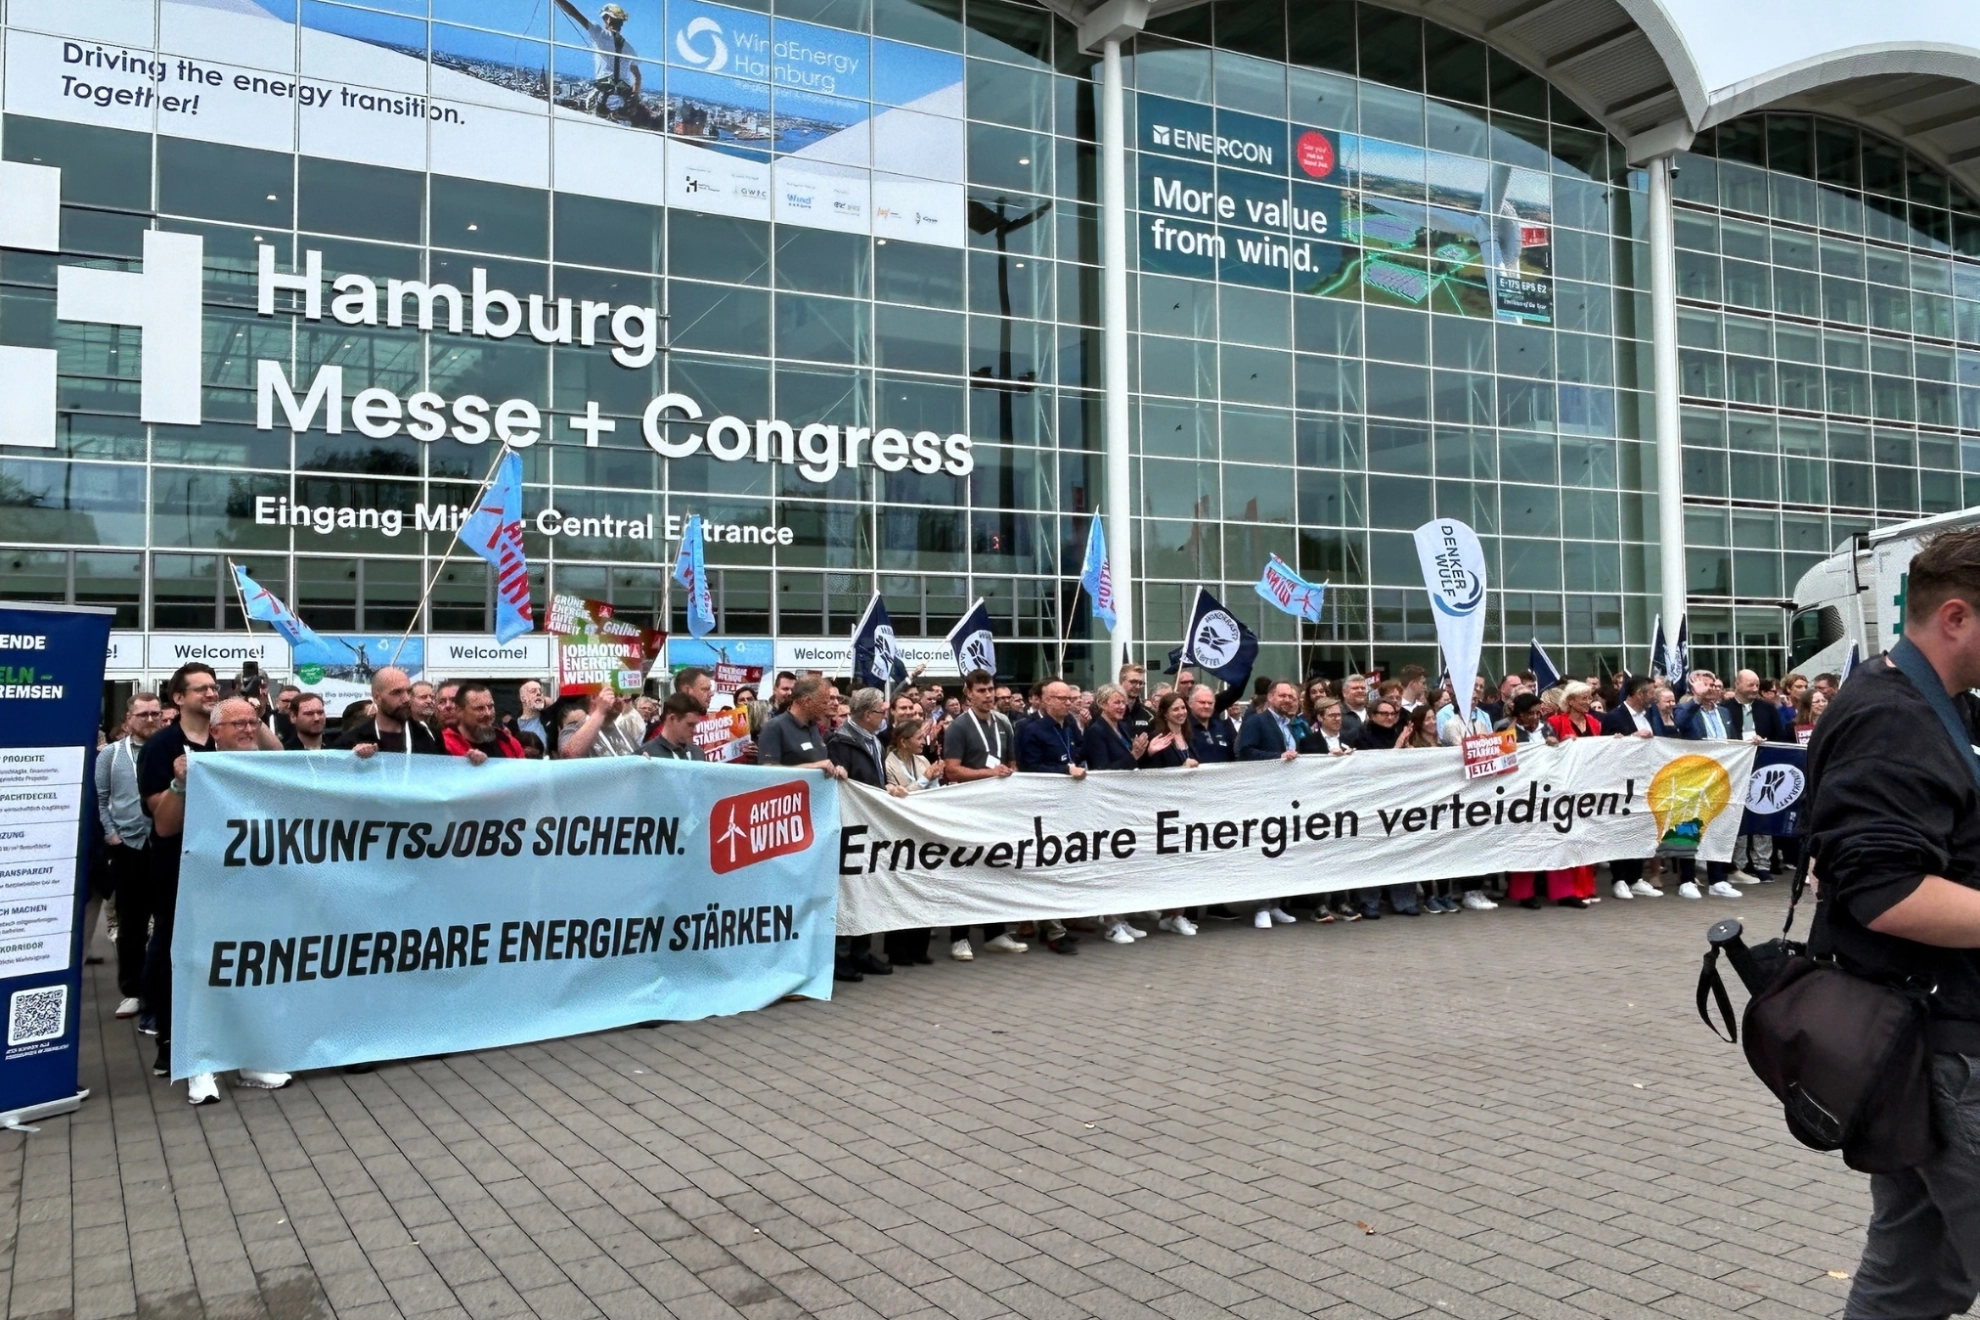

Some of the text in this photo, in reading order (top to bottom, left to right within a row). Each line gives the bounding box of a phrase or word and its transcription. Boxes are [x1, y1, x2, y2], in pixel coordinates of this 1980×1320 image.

[734, 30, 859, 75] WindEnergy
[735, 55, 835, 94] Hamburg
[62, 76, 200, 115] Together!
[63, 42, 466, 125] Driving the energy transition.
[1174, 129, 1272, 165] ENERCON
[1153, 176, 1328, 234] More value
[1152, 219, 1319, 273] from wind.
[257, 244, 656, 369] Hamburg
[257, 360, 974, 482] Messe + Congress
[255, 496, 401, 536] Eingang
[415, 503, 471, 532] Mit
[536, 508, 653, 540] Central
[665, 514, 794, 545] Etrance
[1435, 554, 1456, 597] WULF
[1441, 525, 1467, 589] DENKER
[174, 645, 265, 659] Welcome!
[450, 646, 527, 659] Welcome!
[563, 644, 630, 660] JOBMOTOR
[563, 671, 612, 685] WENDE
[3, 755, 45, 763] PROJEKTE
[750, 792, 802, 825] AKTION
[839, 779, 1634, 876] Erneuerbare Energien verteidigen!
[223, 816, 685, 867] ZUKUNFTSJOBS SICHERN.
[750, 815, 804, 854] WIND
[208, 902, 799, 987] ERNEUERBARE ENERGIEN STÄRKEN.
